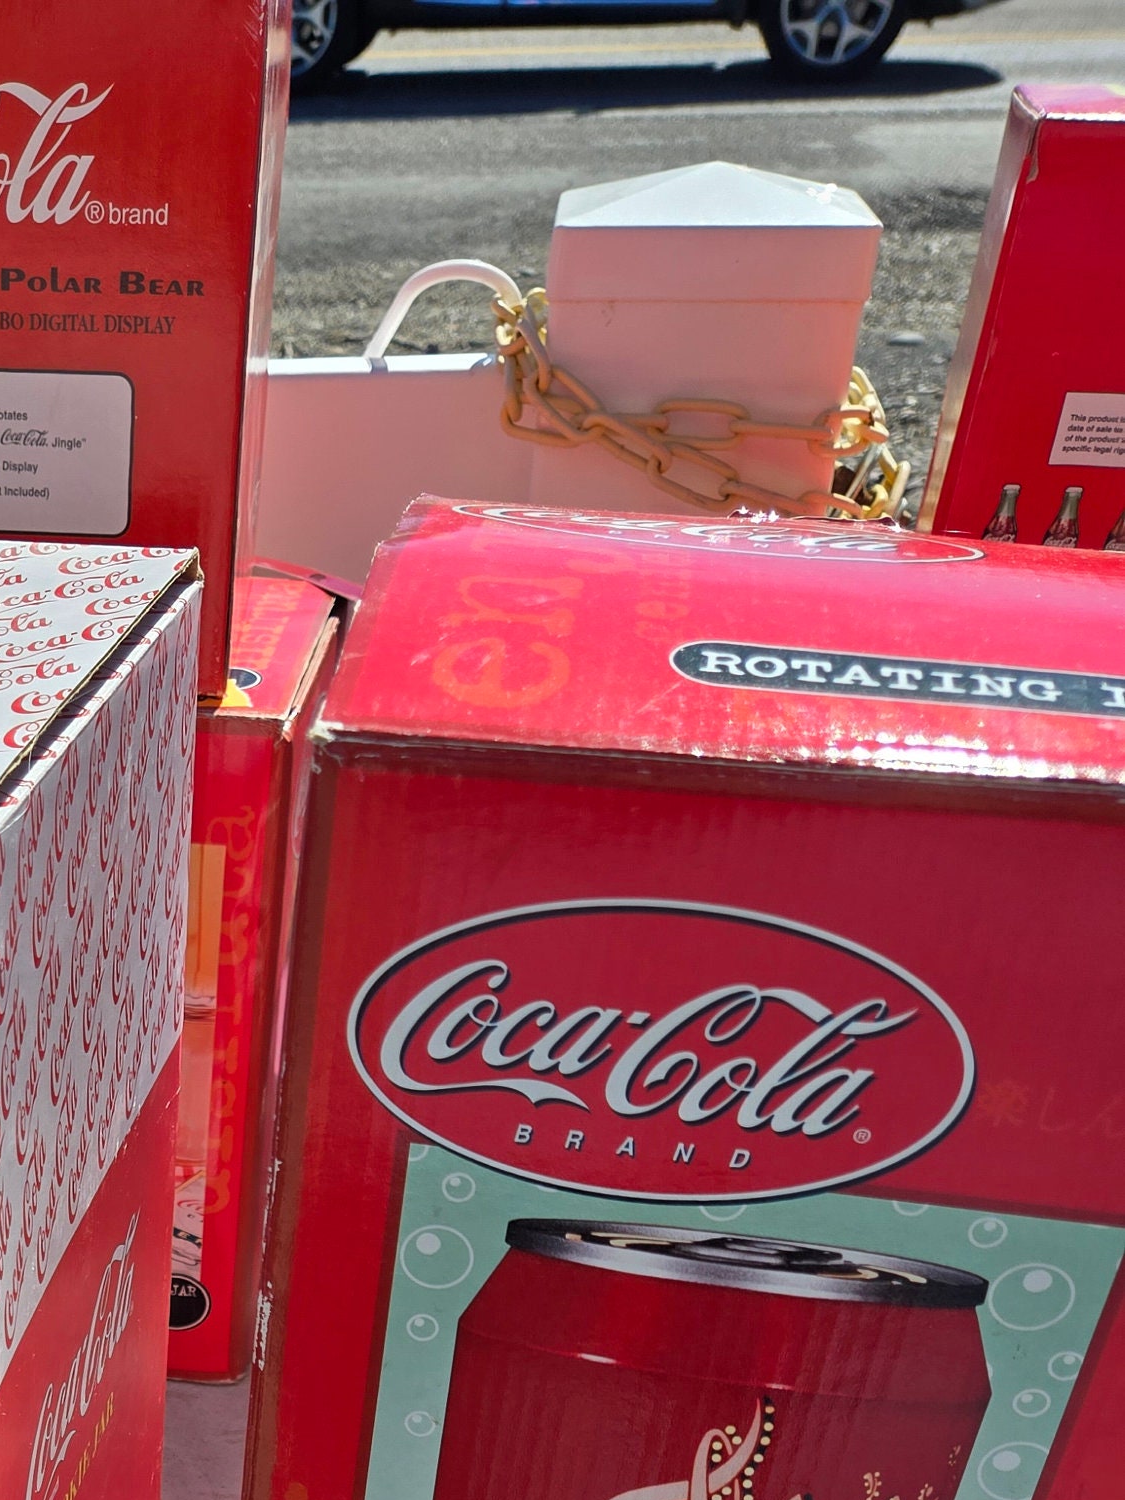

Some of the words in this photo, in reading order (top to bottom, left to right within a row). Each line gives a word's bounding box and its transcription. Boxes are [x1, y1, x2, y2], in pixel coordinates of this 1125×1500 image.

[108, 202, 168, 226] brand
[29, 312, 100, 333] DIGITAL
[104, 314, 176, 335] DISPLAY
[2, 460, 39, 475] Display
[4, 485, 51, 500] Included)
[698, 649, 1064, 703] ROTATING
[378, 958, 920, 1137] Coca-Cola
[514, 1122, 752, 1170] BRAND
